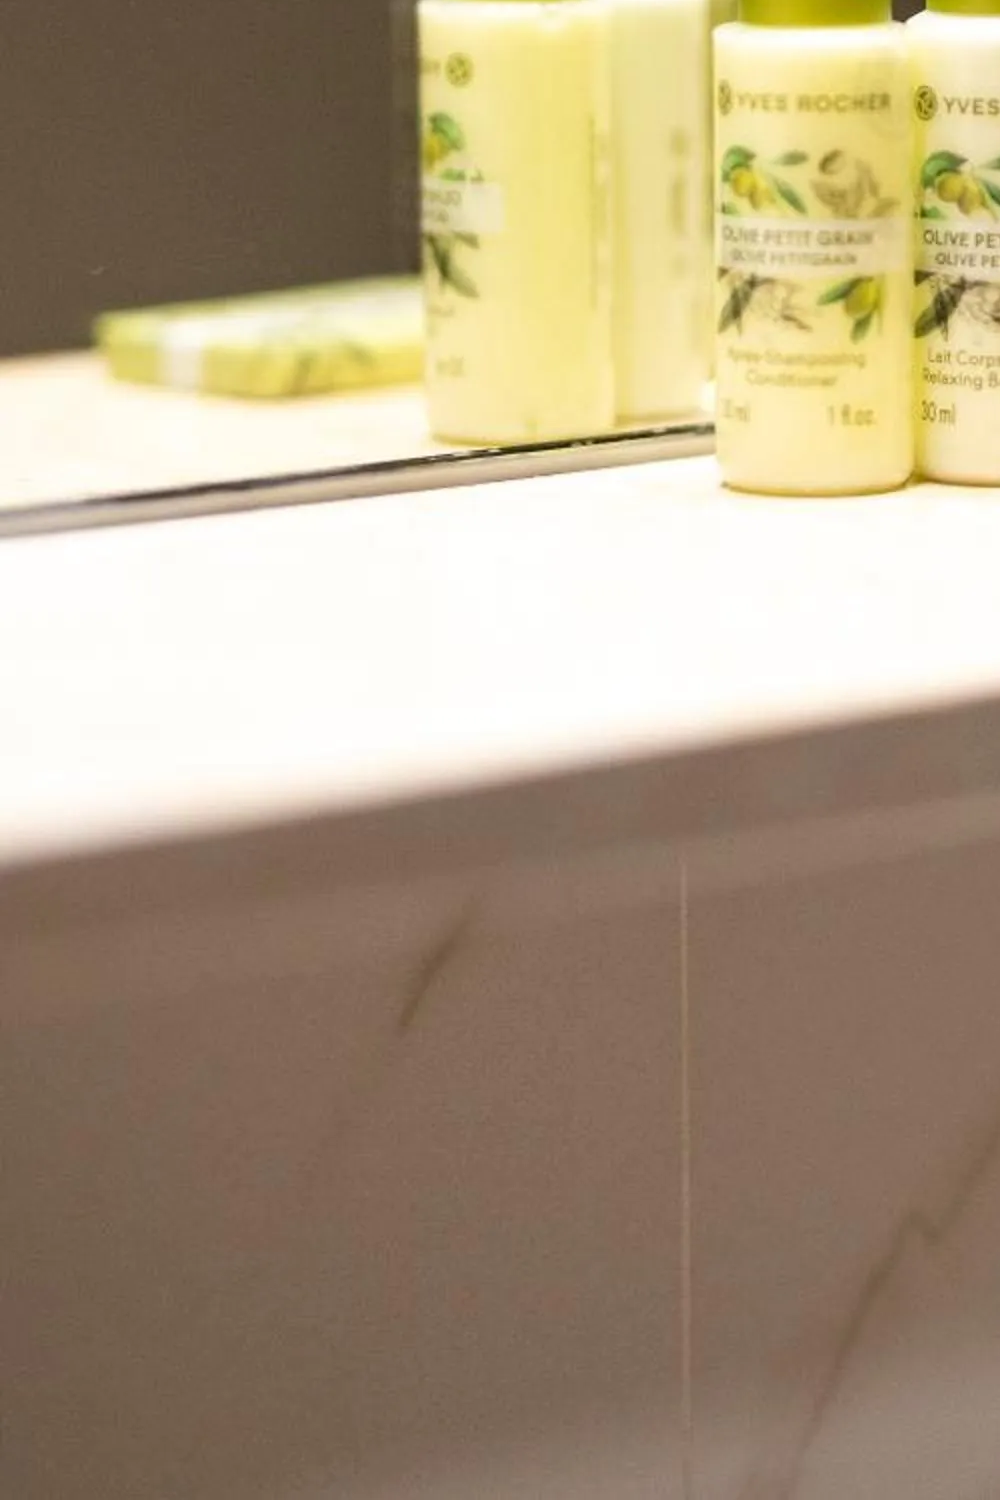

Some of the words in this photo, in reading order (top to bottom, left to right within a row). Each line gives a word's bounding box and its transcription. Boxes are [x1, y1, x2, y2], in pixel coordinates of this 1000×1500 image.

[943, 95, 1000, 116] YVES
[922, 228, 969, 248] OLIVE
[935, 252, 976, 268] OLIVE
[927, 347, 951, 364] Lait
[922, 367, 983, 391] Relaxing
[938, 403, 956, 425] ml
